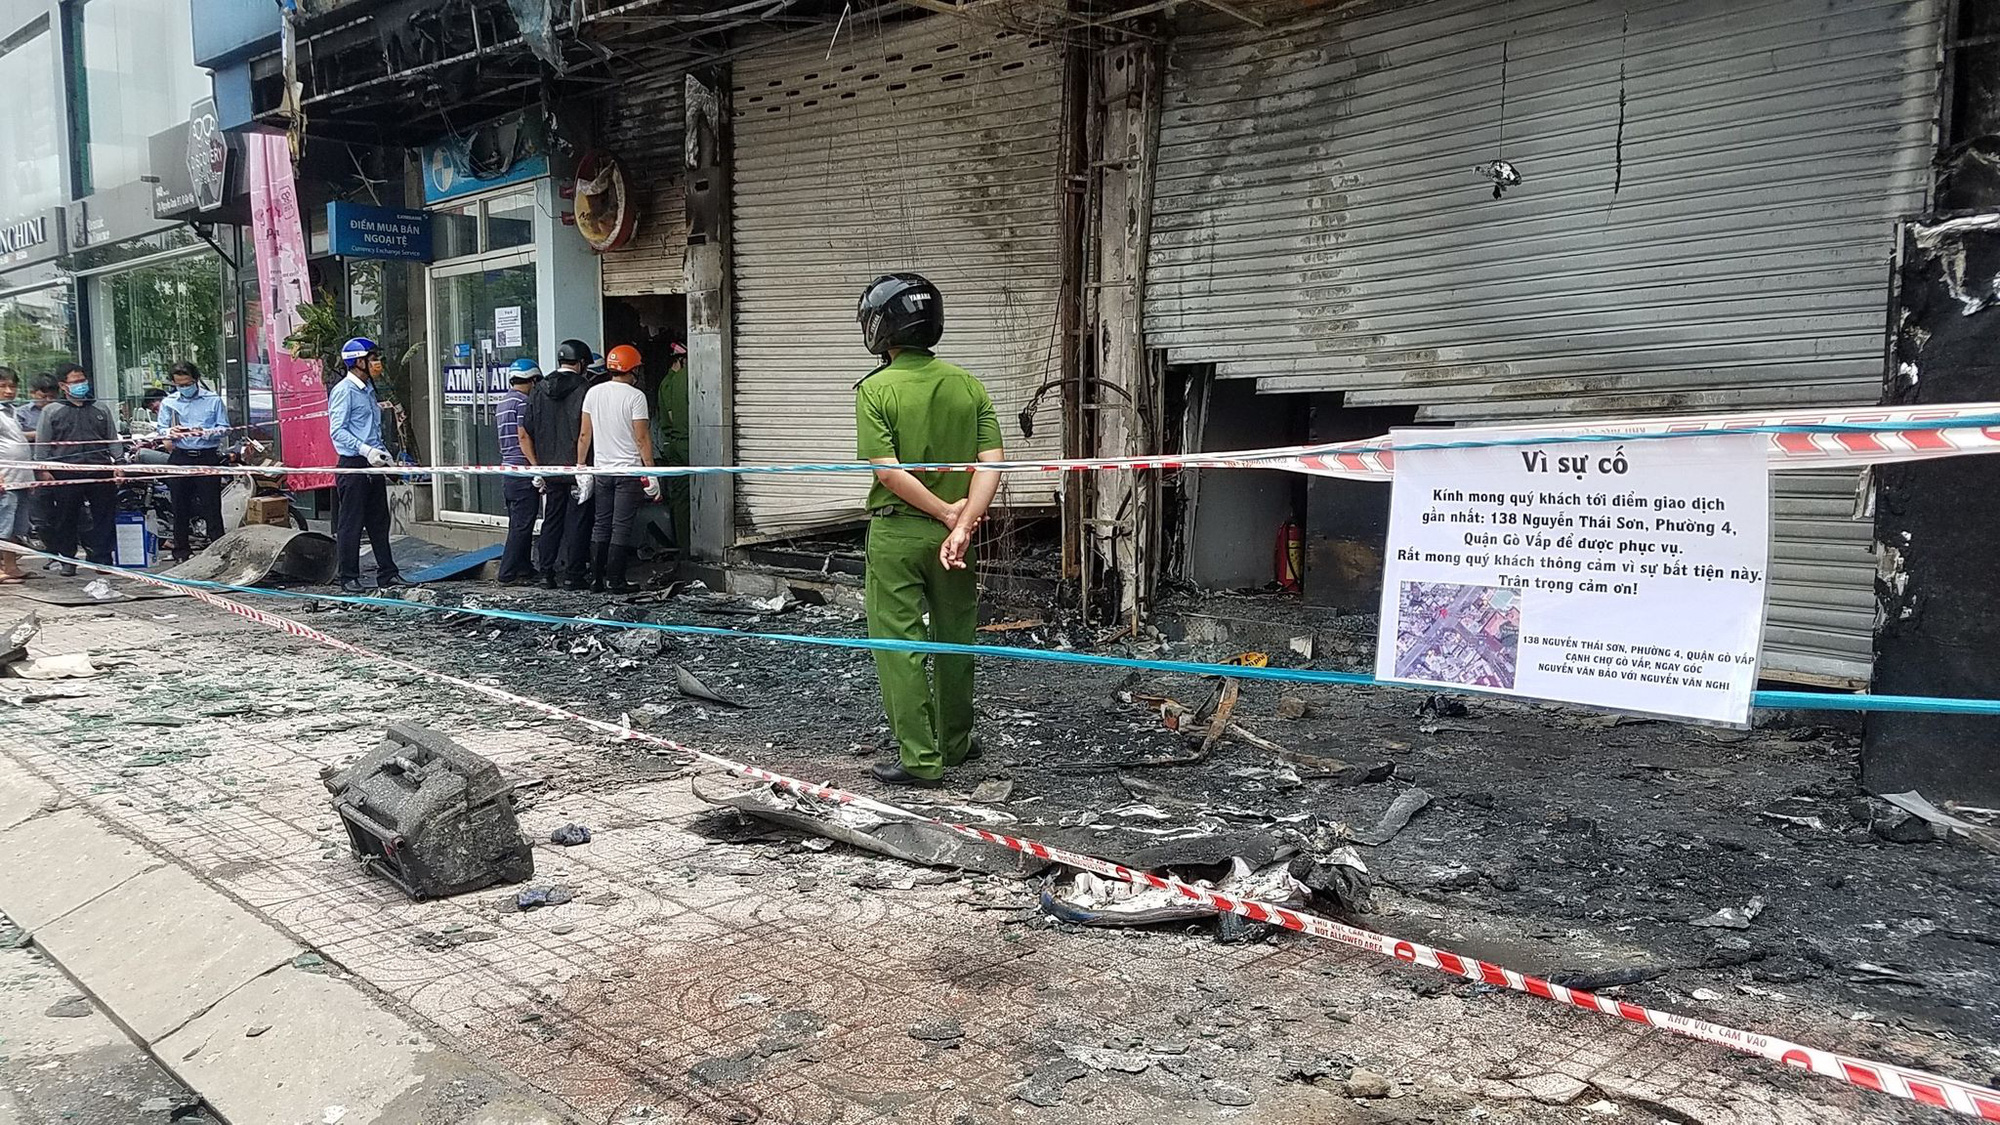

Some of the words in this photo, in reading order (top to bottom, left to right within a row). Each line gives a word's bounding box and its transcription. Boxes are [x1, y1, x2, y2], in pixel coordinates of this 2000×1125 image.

[364, 234, 395, 246] NGOẠI
[396, 235, 408, 247] TỆ
[377, 223, 398, 233] MUA
[400, 224, 420, 235] BÁN
[351, 245, 375, 254] Currency
[376, 247, 401, 256] Exchange
[447, 369, 472, 391] ATM
[1522, 449, 1548, 473] Vì
[1558, 454, 1588, 480] sự
[1598, 445, 1629, 474] cố
[1433, 488, 1463, 502] Kính
[1468, 492, 1505, 506] mong
[1510, 490, 1534, 507] quý
[1539, 492, 1581, 505] khách
[1586, 492, 1606, 507] tới
[1612, 491, 1648, 508] điểm
[1654, 496, 1686, 511] giao
[1692, 497, 1725, 514] dịch
[1422, 506, 1445, 524] gần
[1450, 507, 1485, 524] nhất:
[1491, 512, 1517, 525] 138
[1522, 510, 1574, 529] Nguyễn
[1579, 515, 1611, 528] Thái
[1616, 516, 1649, 532] Sơn,
[1656, 518, 1715, 536] Phường
[1721, 521, 1737, 536] 4,
[1464, 532, 1498, 548] Quận
[1503, 533, 1520, 546] Gò
[1525, 531, 1551, 550] Vấp
[1556, 532, 1575, 548] để
[1578, 538, 1614, 554] được
[1619, 540, 1655, 556] phục
[1661, 543, 1683, 557] vụ.
[1397, 546, 1420, 561] Rất
[1425, 551, 1461, 566] mong
[1466, 553, 1489, 568] quý
[1494, 554, 1535, 568] khách
[1540, 556, 1582, 573] thông
[1587, 557, 1616, 572] cảm
[1622, 560, 1635, 573] vì
[1640, 563, 1658, 578] sự
[1663, 559, 1688, 576] bất
[1694, 564, 1724, 582] tiện
[1730, 566, 1762, 584] này.
[1499, 574, 1530, 588] Trân
[1535, 579, 1573, 594] trọng
[1579, 579, 1607, 593] cảm
[1614, 582, 1638, 595] ơn!
[1523, 636, 1540, 645] 138
[1542, 636, 1578, 648] NGUYỄN
[1581, 640, 1603, 651] THÁI
[1606, 643, 1628, 654] SƠN,
[1631, 645, 1671, 658] PHƯỜNG
[1687, 650, 1714, 663] QUẬN
[1718, 652, 1731, 662] GÒ
[1735, 652, 1755, 665] VẤP
[1566, 653, 1590, 664] CẠNH
[1593, 655, 1614, 667] CHỢ
[1616, 655, 1628, 666] GÒ
[1655, 661, 1680, 672] NGAY
[1684, 662, 1703, 674] GÓC
[1538, 662, 1573, 674] NGUYỄN
[1577, 667, 1595, 676] VĂN
[1598, 667, 1618, 679] BẢO
[1621, 670, 1637, 681] VỚI
[1640, 672, 1679, 685] NGUYỄN
[1683, 677, 1702, 688] VĂN
[1315, 926, 1329, 937] NOT
[1330, 931, 1363, 946] ALLOWED
[1365, 940, 1383, 953] AREA
[1668, 1014, 1689, 1026] KHU
